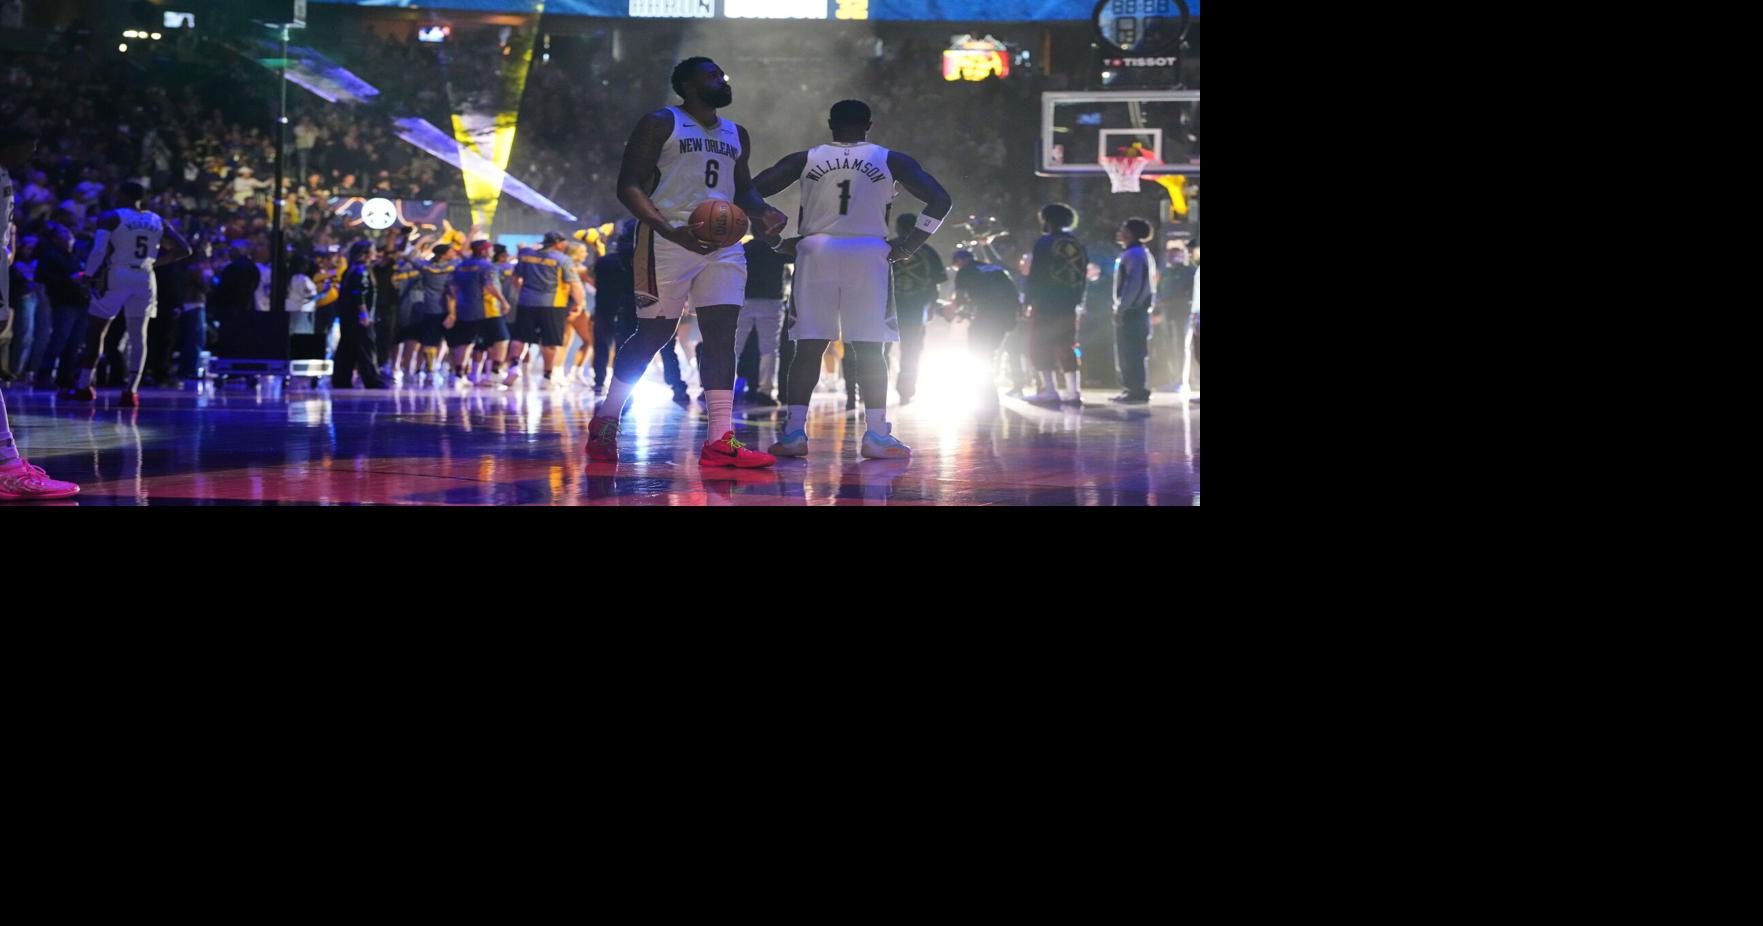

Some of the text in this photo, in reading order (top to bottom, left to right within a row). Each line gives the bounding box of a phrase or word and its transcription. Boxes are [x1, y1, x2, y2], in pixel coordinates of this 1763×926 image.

[1123, 56, 1177, 67] TISSOT
[680, 138, 738, 160] NEW ORLEAN
[705, 159, 719, 188] 6
[806, 158, 886, 183] WILLIAMSON
[837, 180, 851, 215] 1
[134, 236, 148, 259] 5
